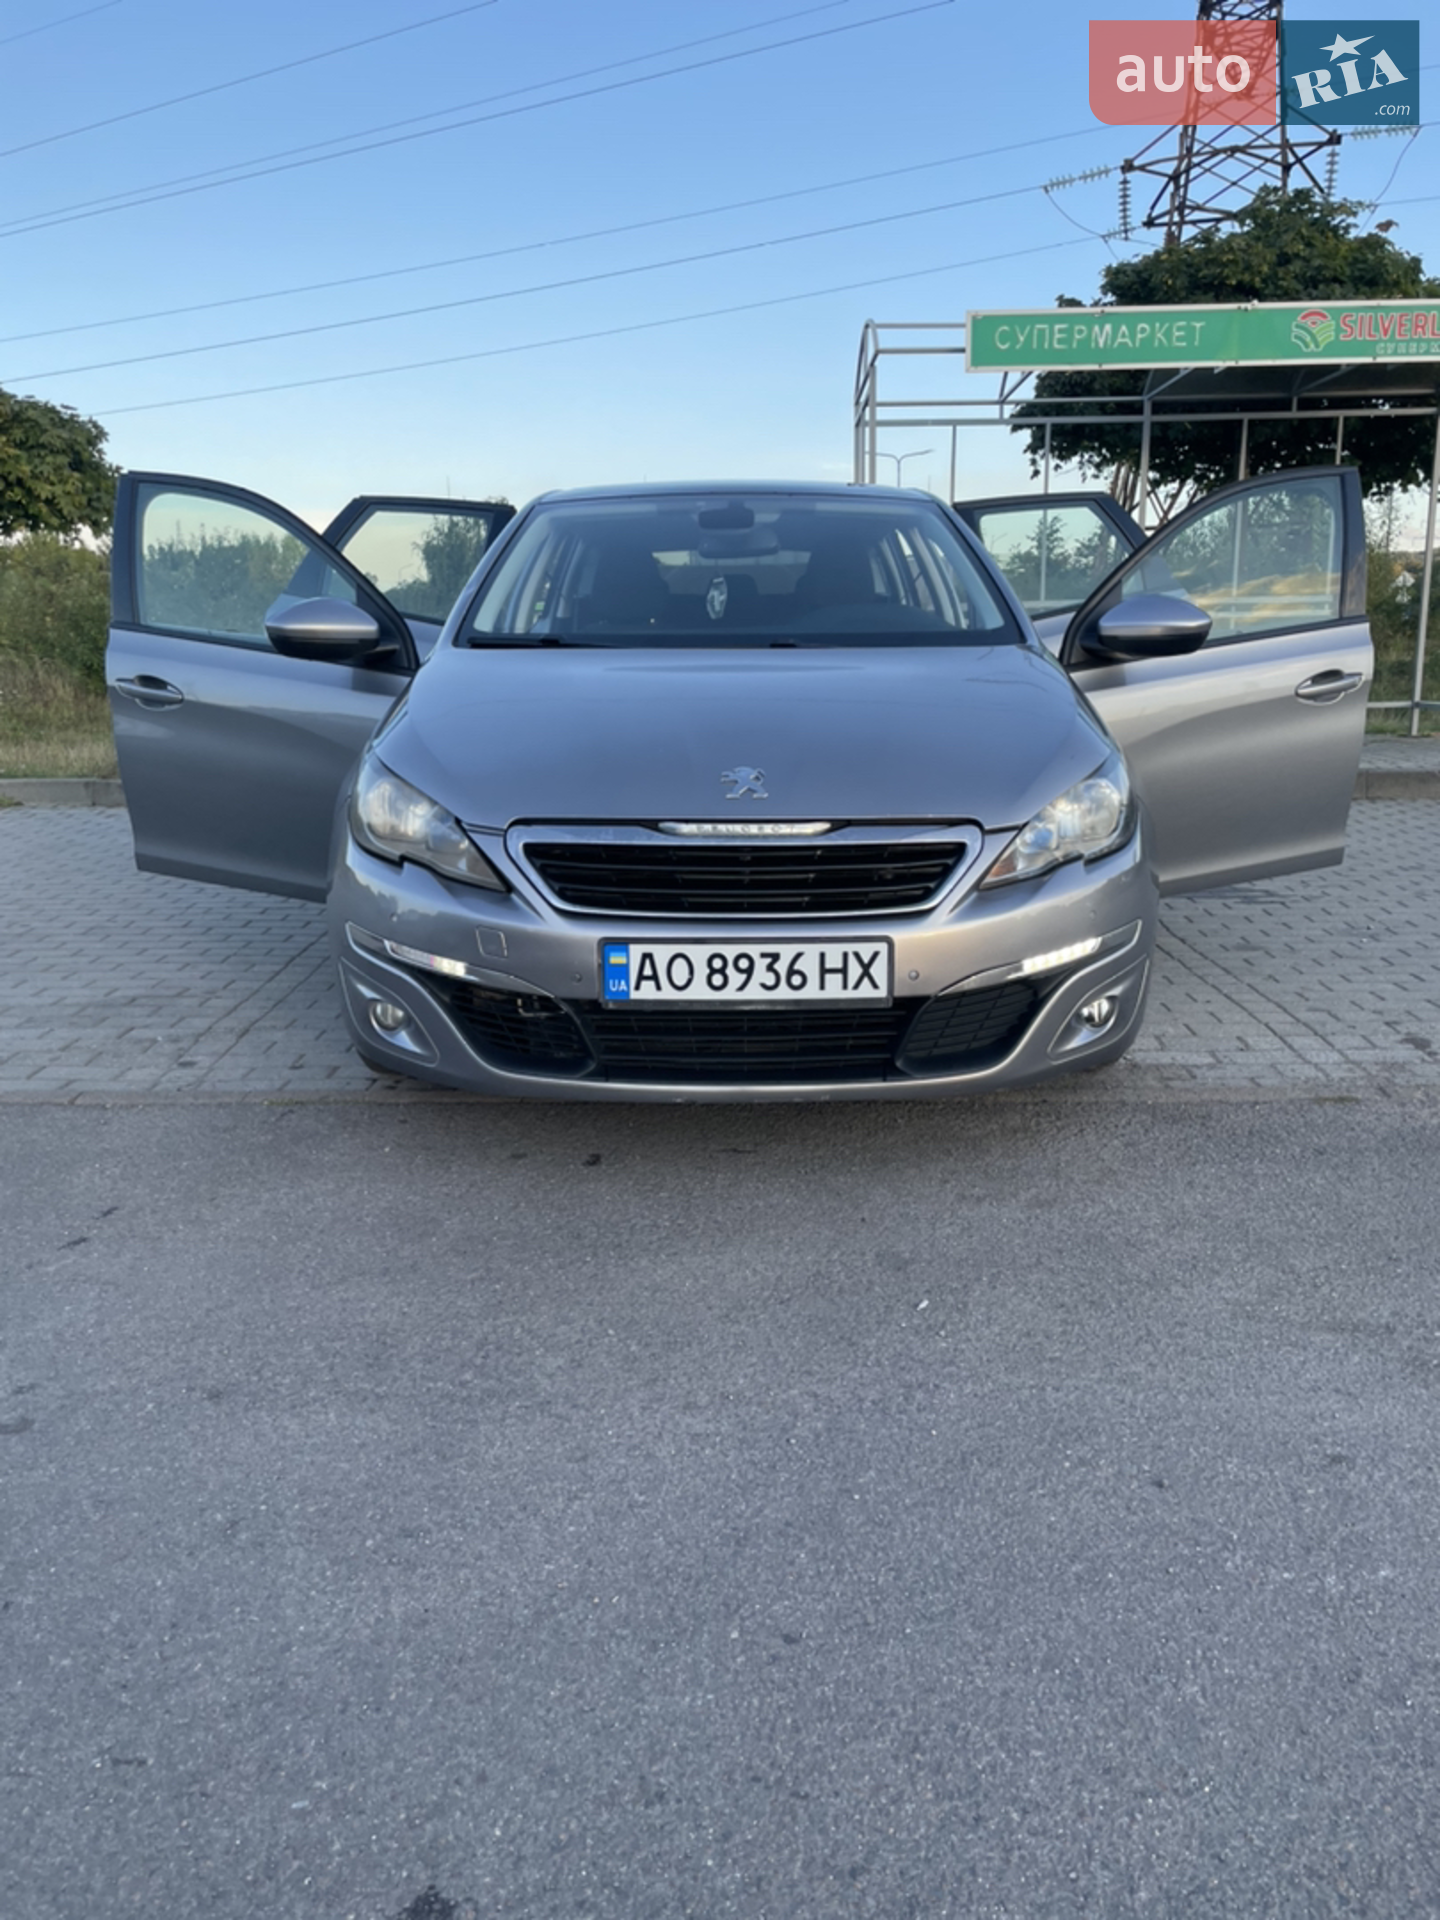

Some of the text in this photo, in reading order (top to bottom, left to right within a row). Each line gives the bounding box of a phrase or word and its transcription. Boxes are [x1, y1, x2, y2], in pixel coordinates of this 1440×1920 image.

[994, 321, 1206, 350] СУПЕРМАРКЕТ
[609, 979, 628, 992] UA
[705, 952, 808, 992] 8936
[818, 950, 881, 991] HX
